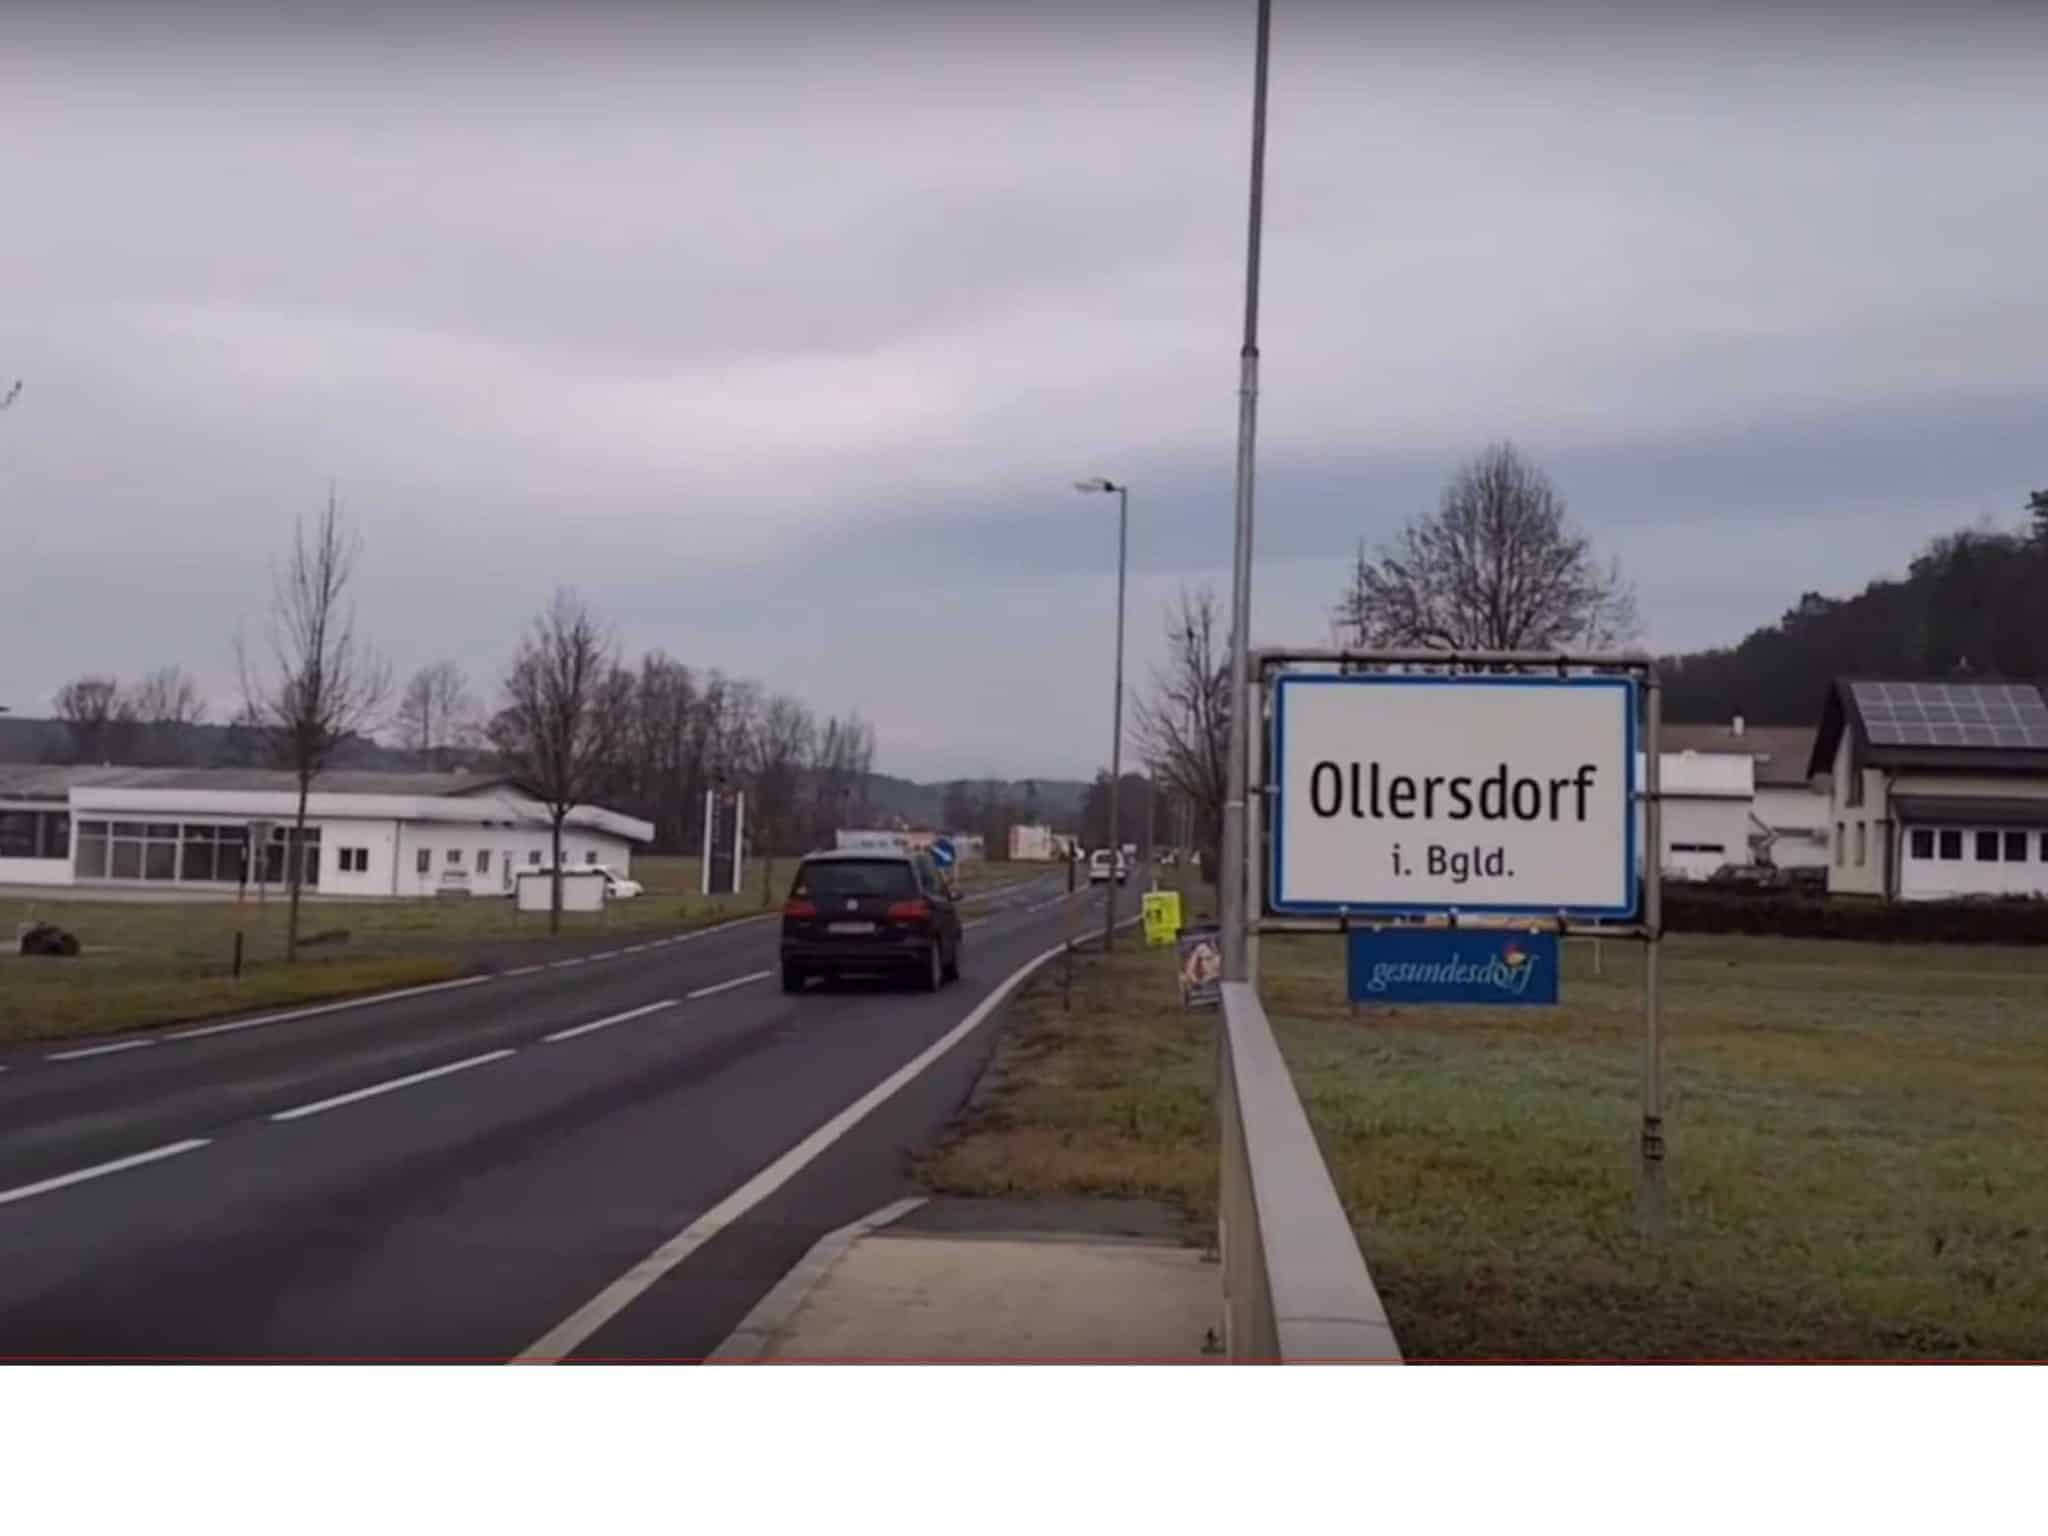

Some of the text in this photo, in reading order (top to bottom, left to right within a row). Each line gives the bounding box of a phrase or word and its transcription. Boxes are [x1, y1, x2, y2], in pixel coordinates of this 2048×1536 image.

[1309, 760, 1598, 822] Ollersdorf
[1391, 843, 1515, 883] i. Bgld.
[1365, 951, 1541, 996] gesundesdorf
